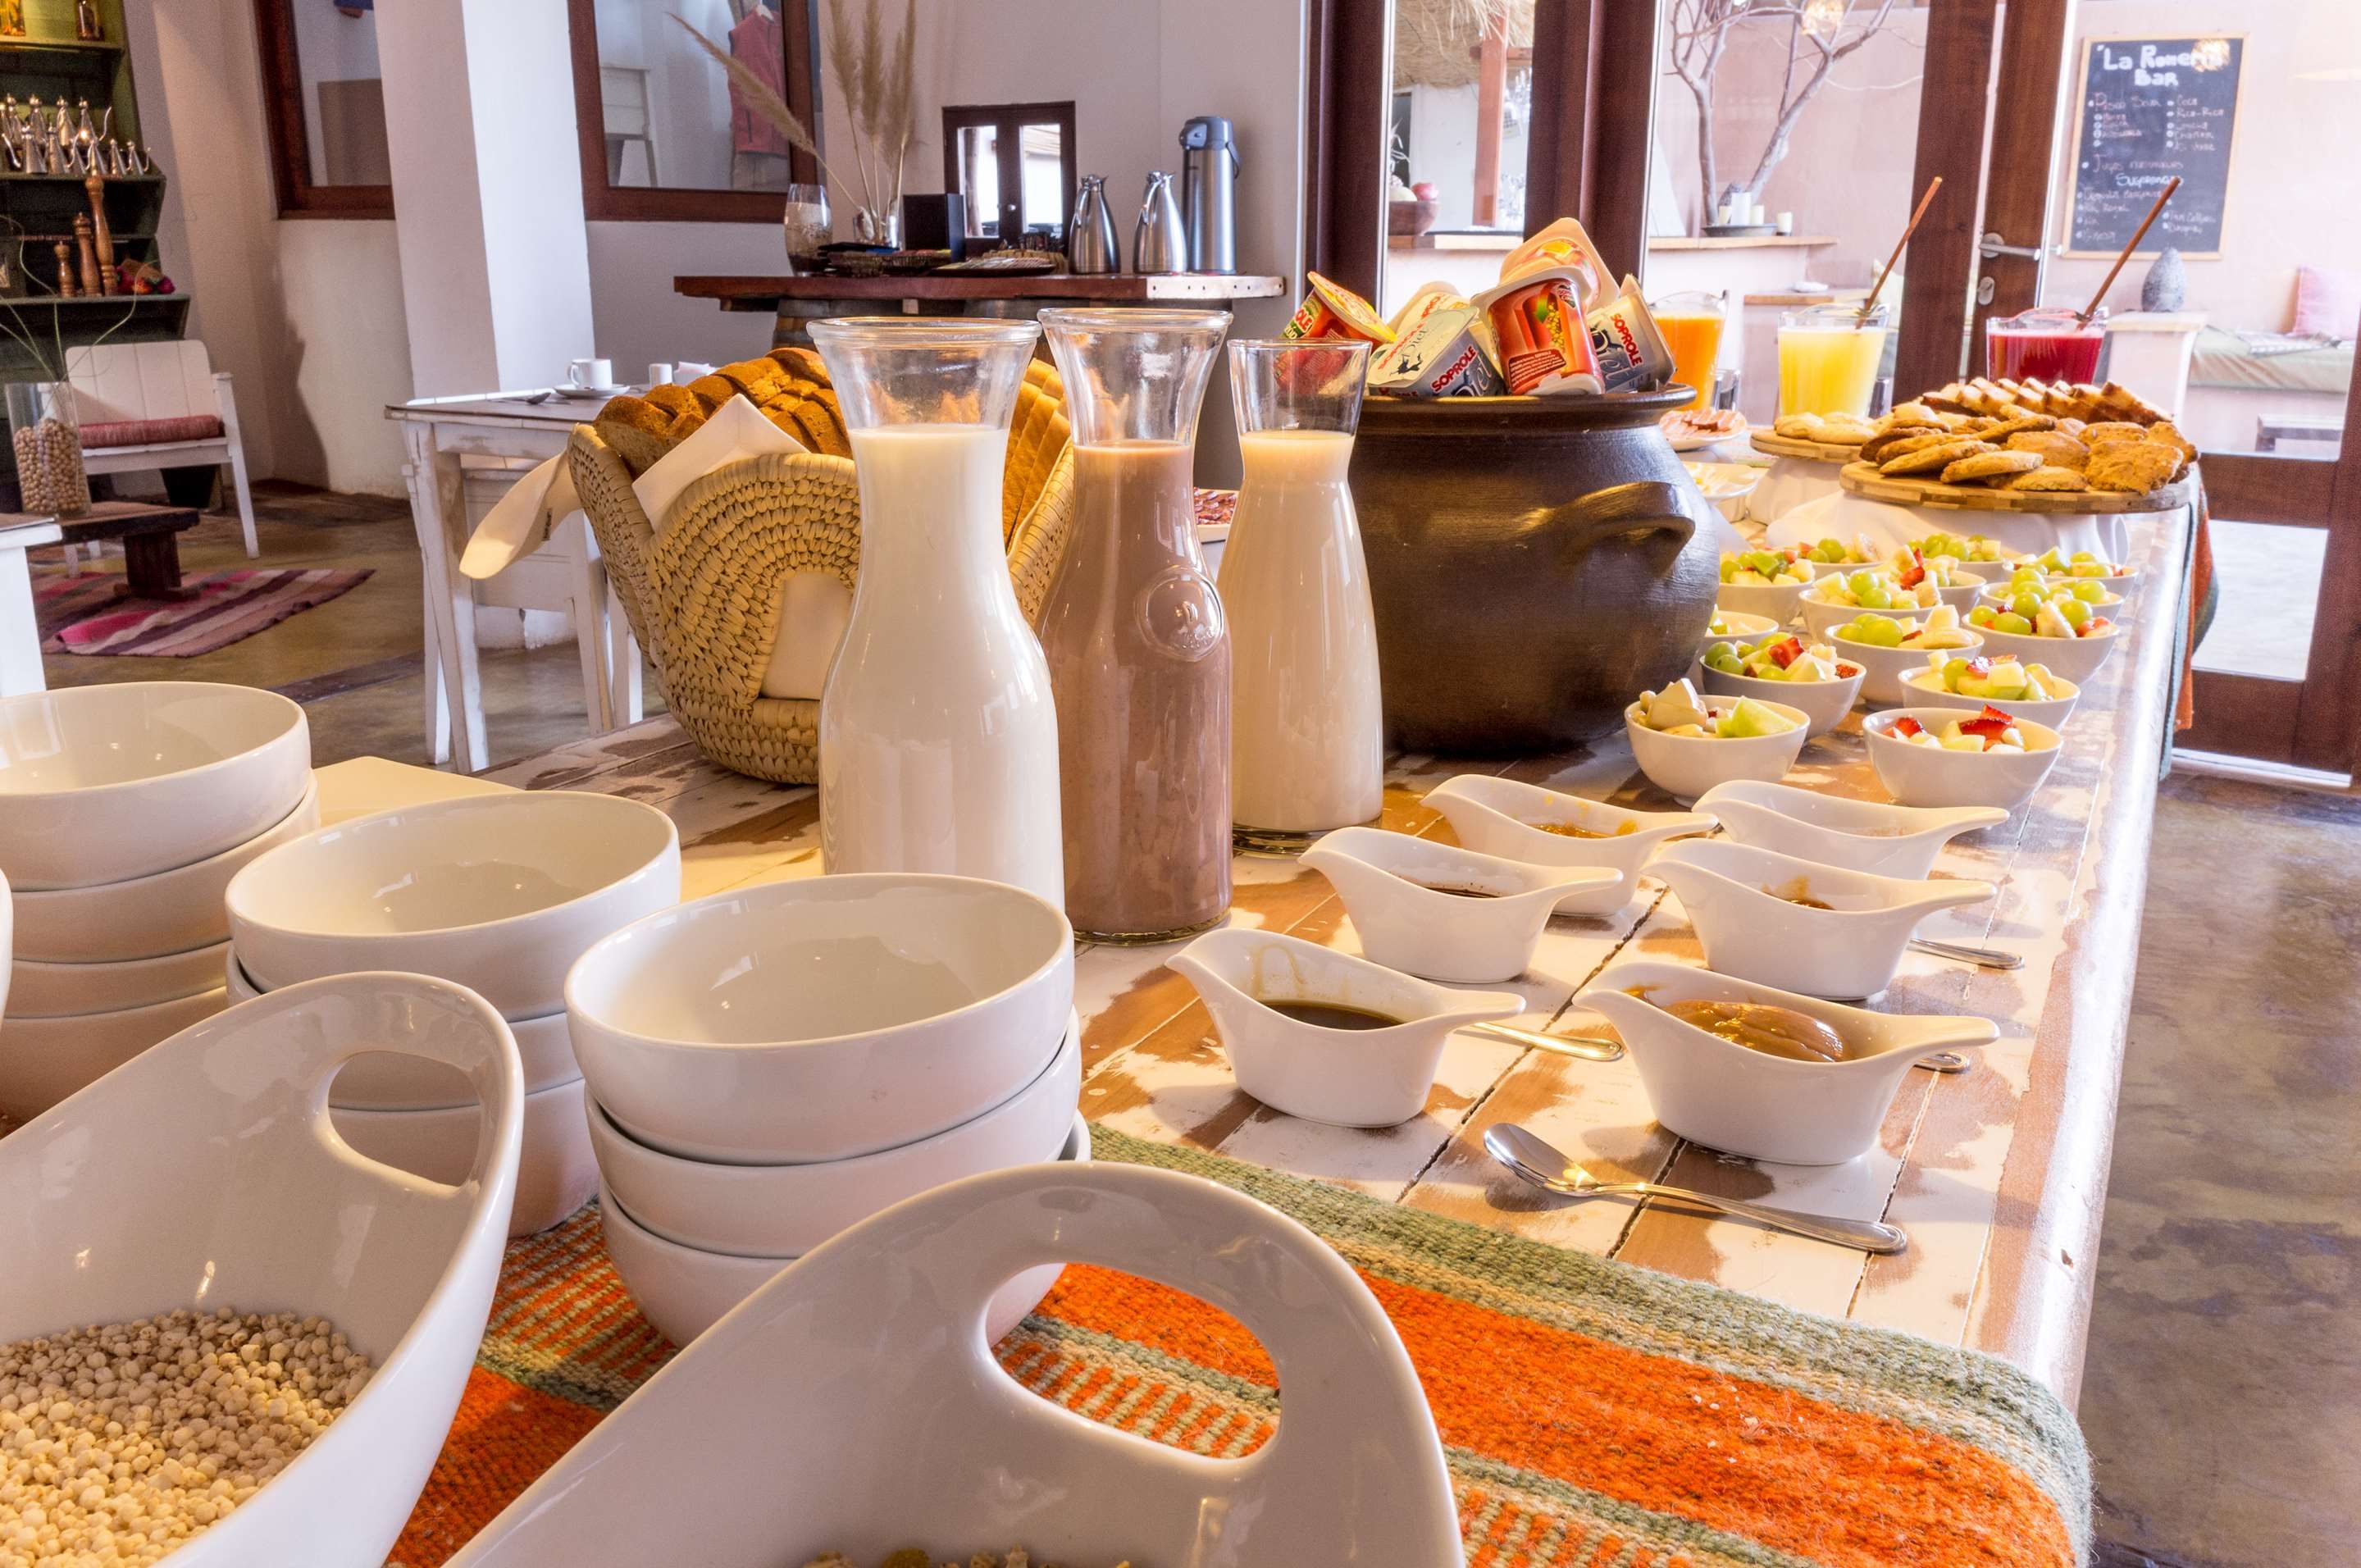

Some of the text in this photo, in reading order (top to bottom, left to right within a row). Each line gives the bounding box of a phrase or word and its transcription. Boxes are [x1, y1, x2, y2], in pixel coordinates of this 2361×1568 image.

[2103, 48, 2133, 71] La
[1611, 313, 1643, 367] SOPROLE
[1430, 344, 1477, 392] SOPROLE
